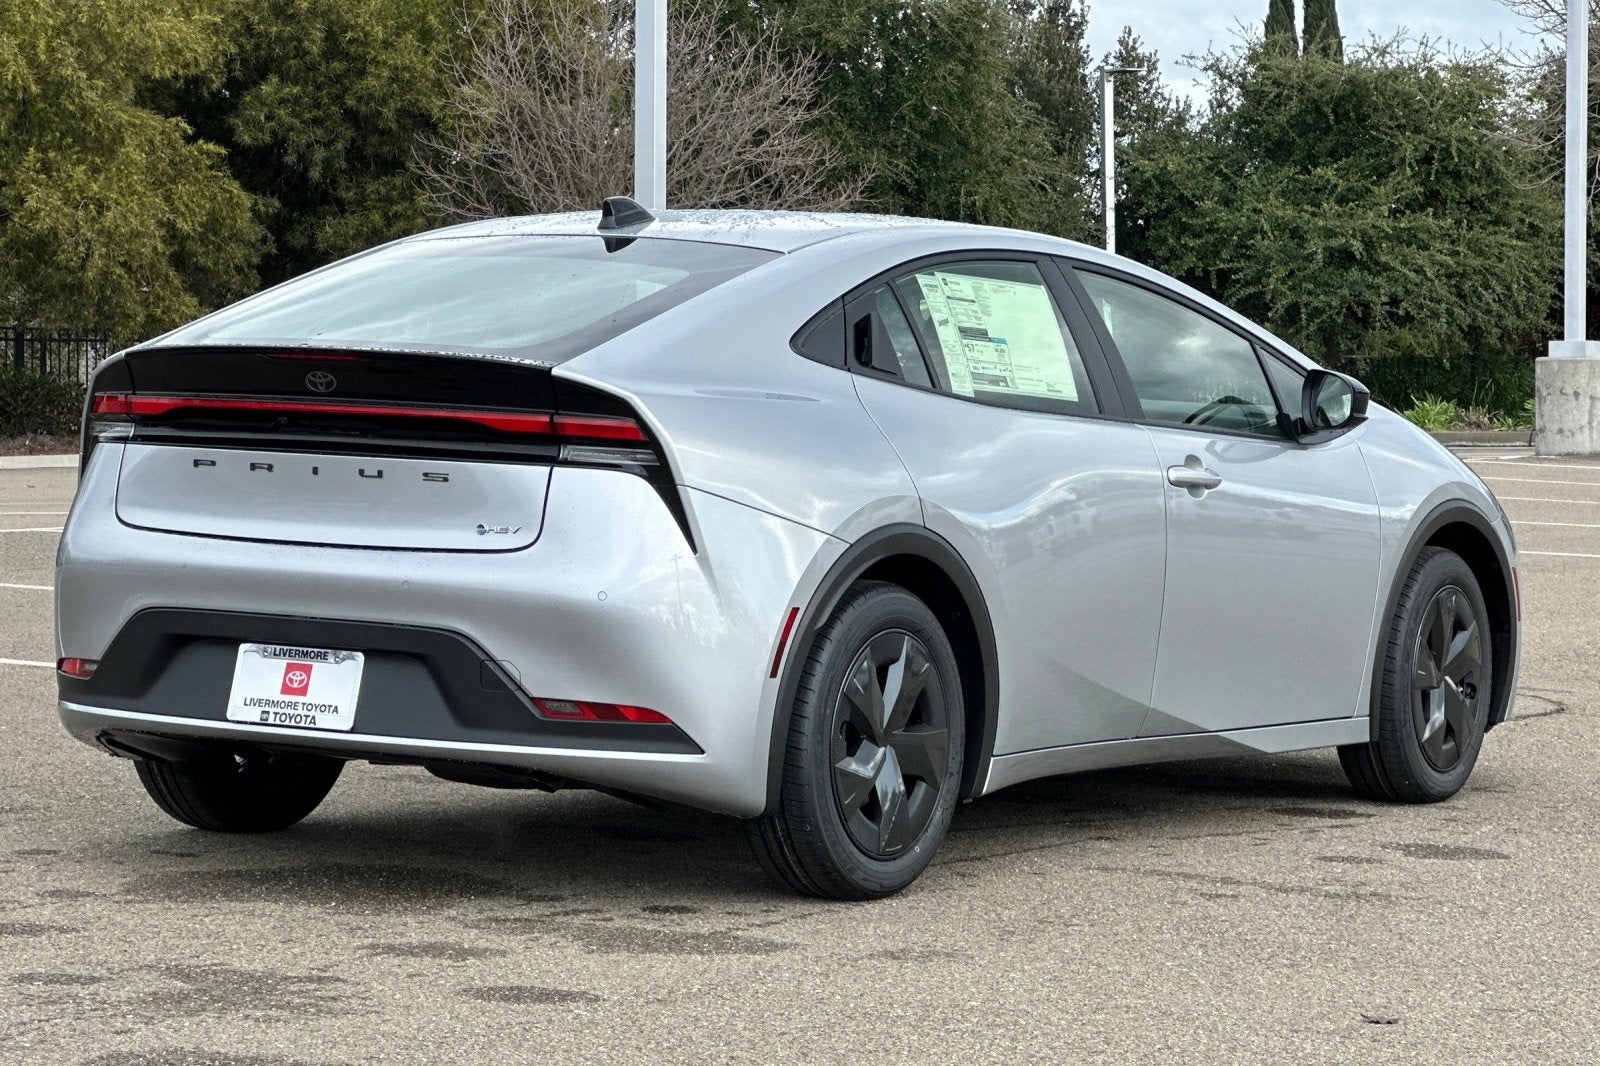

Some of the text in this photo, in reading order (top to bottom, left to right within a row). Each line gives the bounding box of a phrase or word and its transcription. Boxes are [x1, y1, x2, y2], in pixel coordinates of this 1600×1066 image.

[193, 459, 449, 482] PRIUS
[273, 647, 329, 661] LIVERMORE
[243, 697, 339, 714] LIVERMORE TOYOTA
[273, 711, 317, 726] TOYOTA
